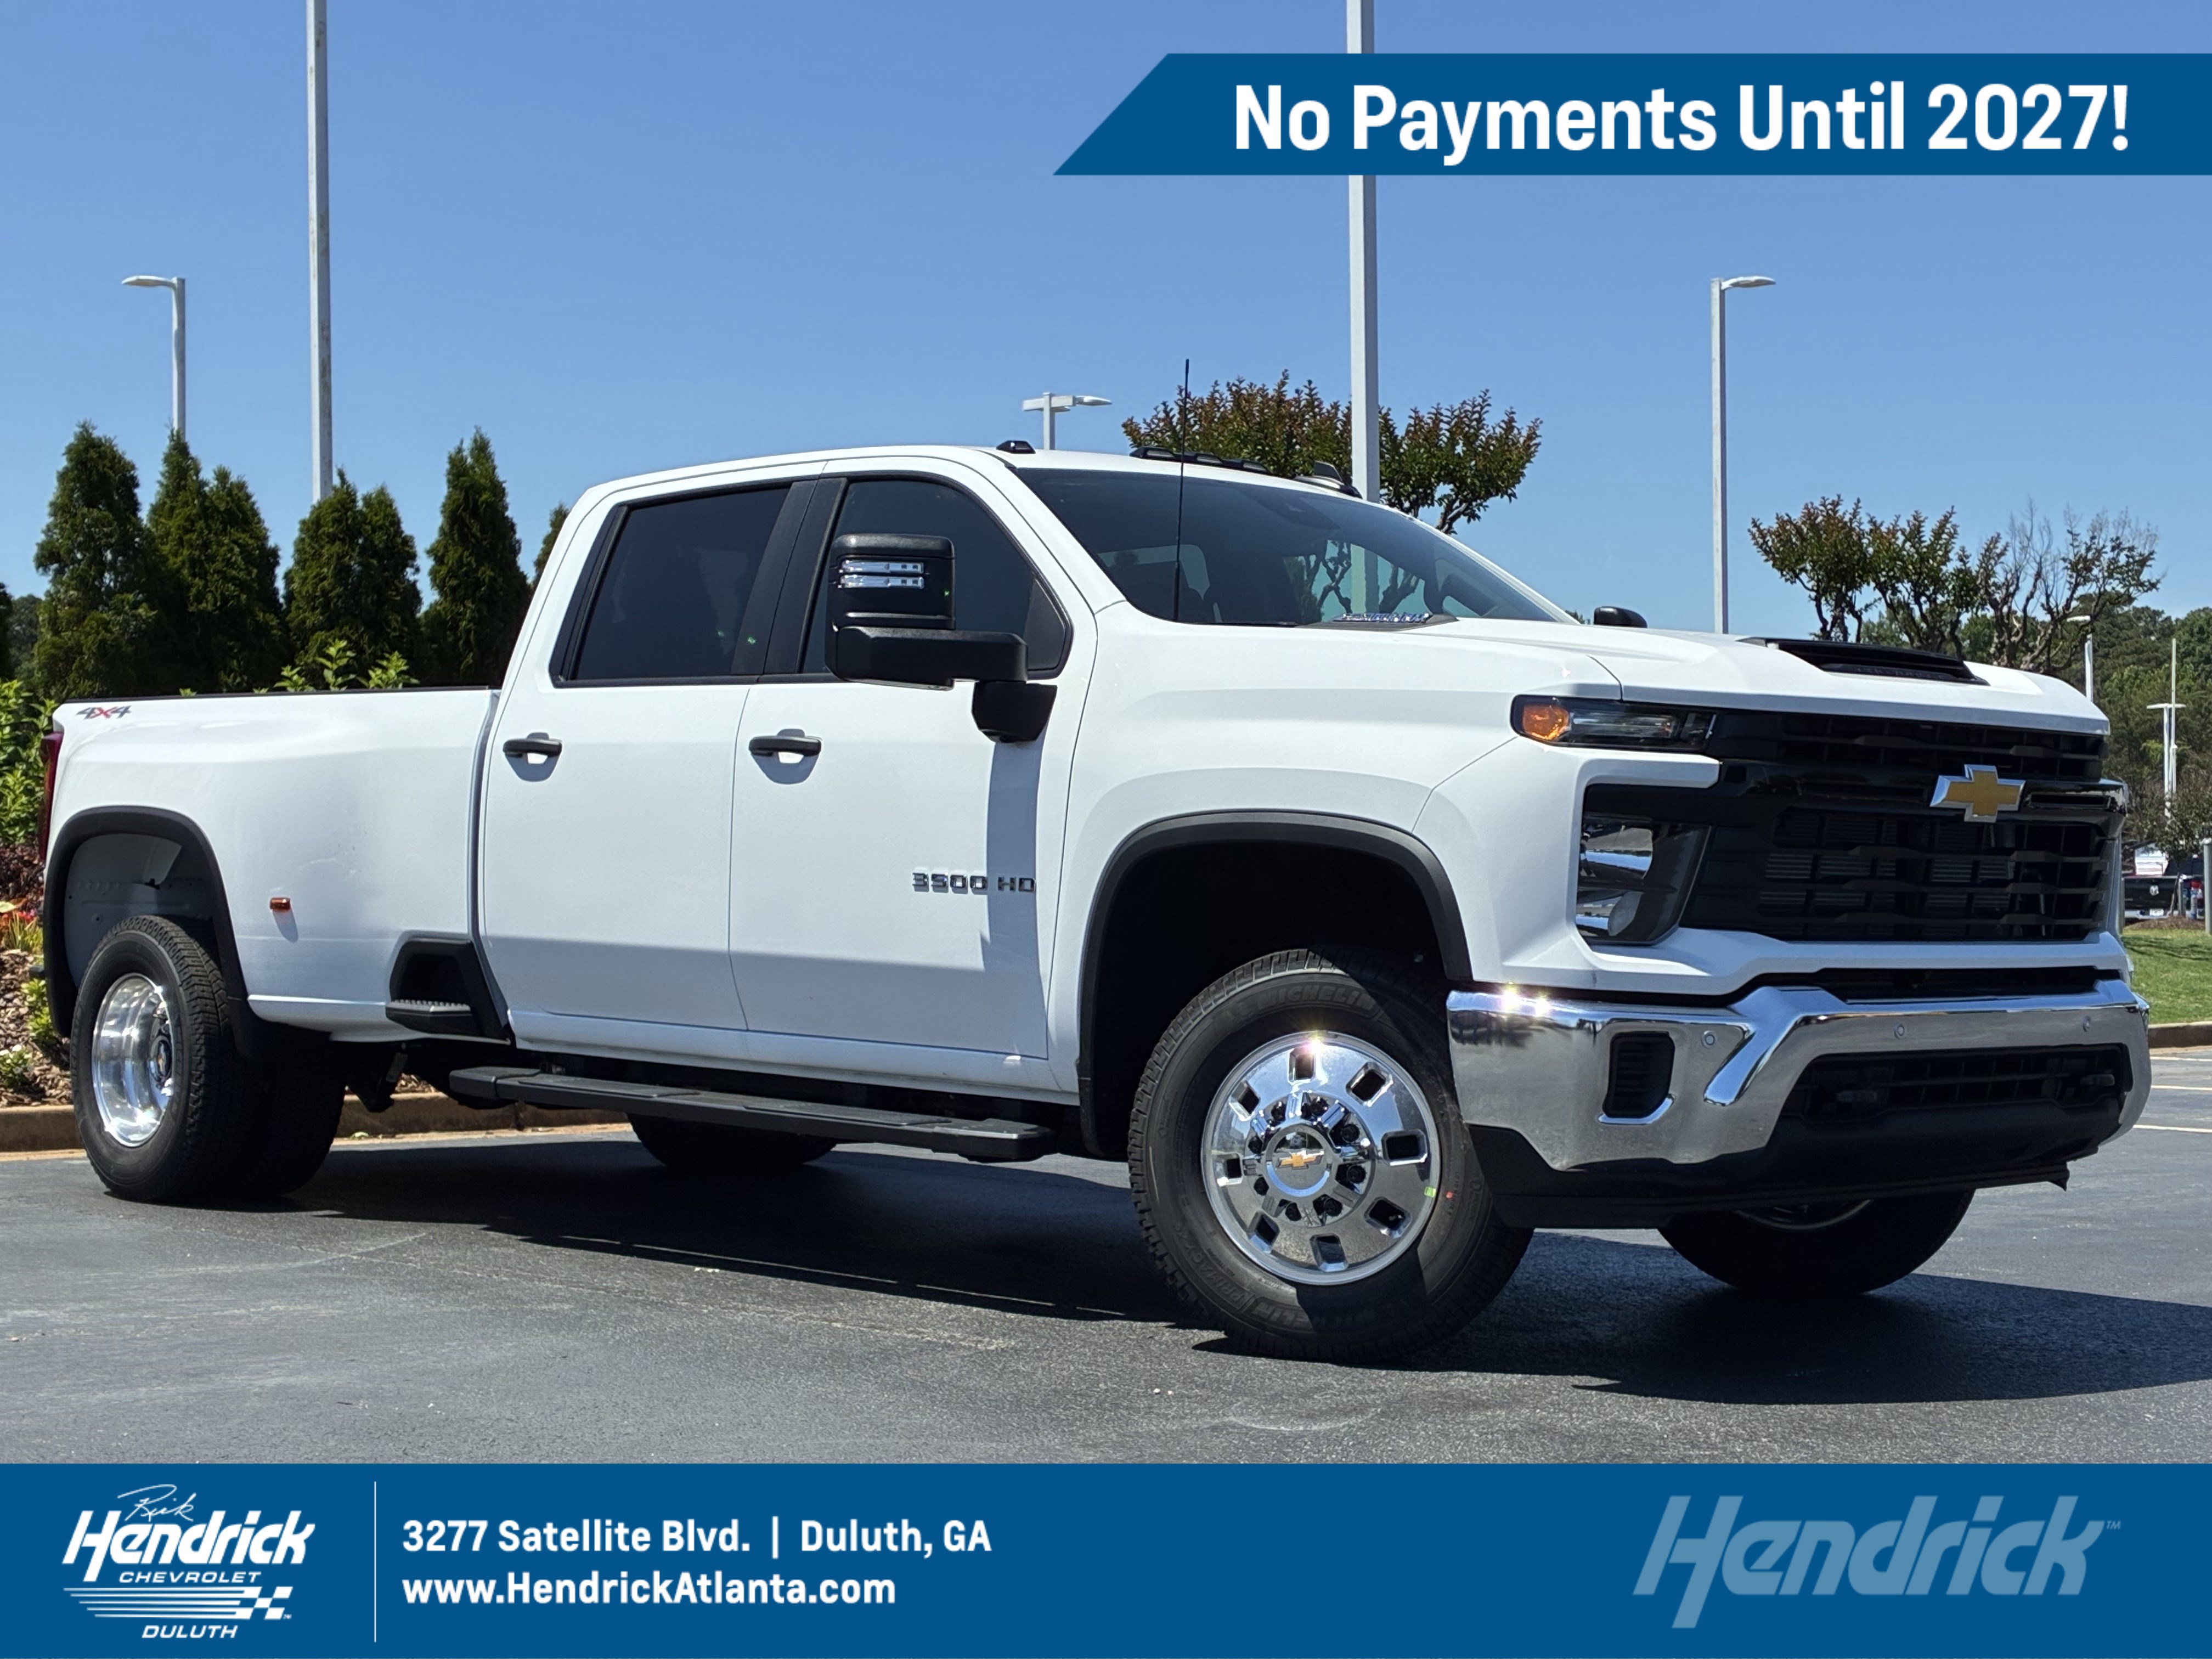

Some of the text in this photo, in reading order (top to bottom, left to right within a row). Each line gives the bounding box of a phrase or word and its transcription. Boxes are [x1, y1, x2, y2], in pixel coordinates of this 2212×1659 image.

[913, 872, 1036, 893] 3500 HD
[1256, 985, 1376, 1012] MICHELIN
